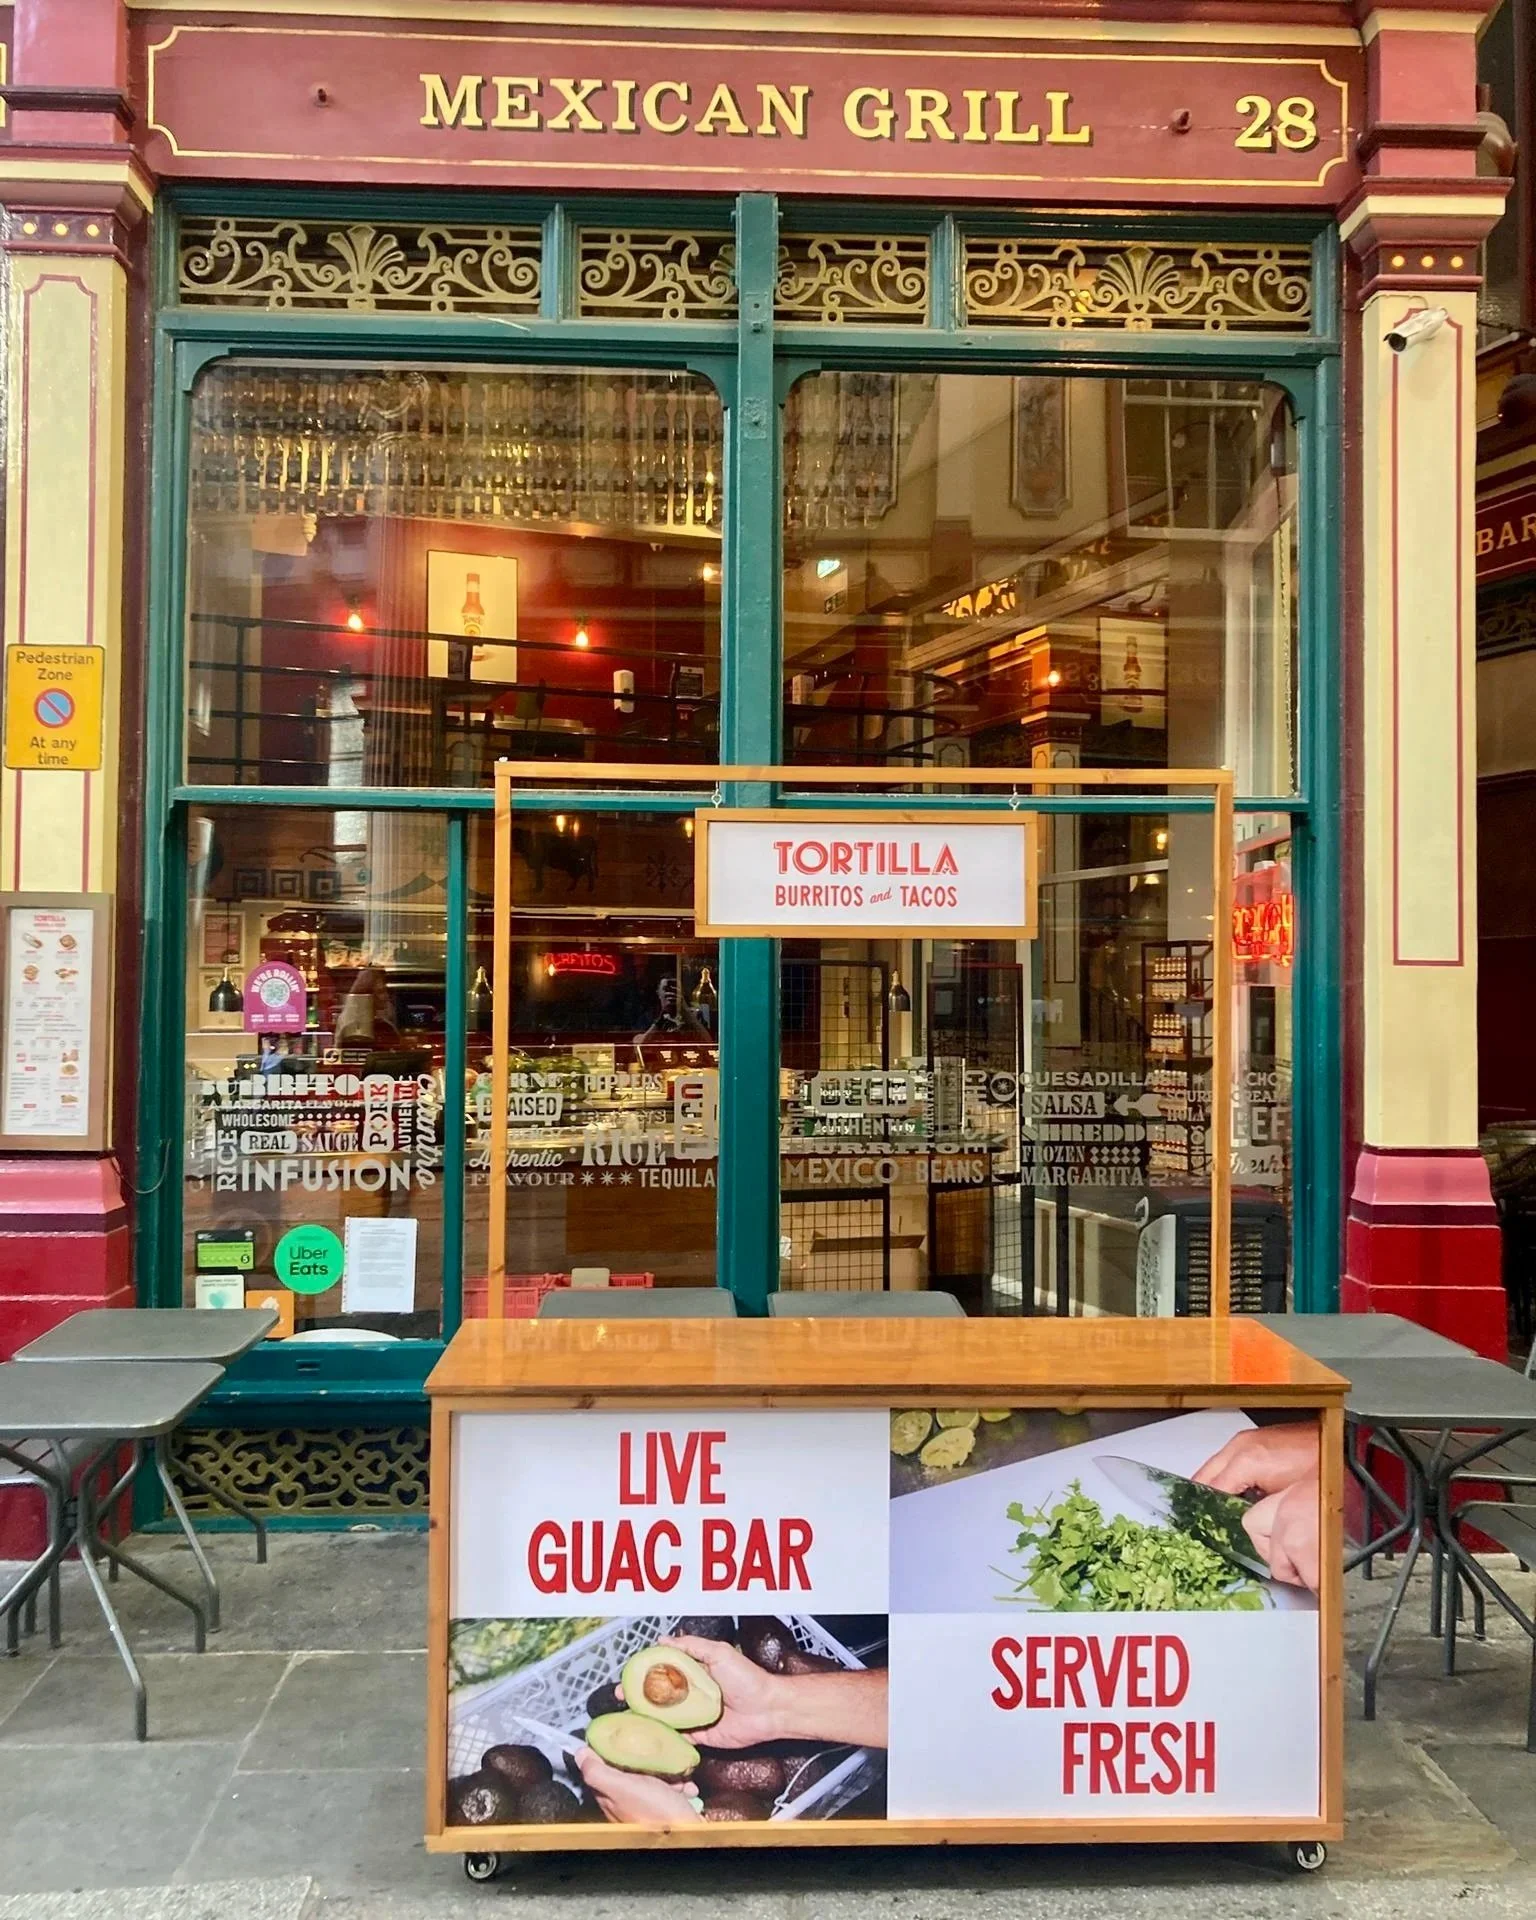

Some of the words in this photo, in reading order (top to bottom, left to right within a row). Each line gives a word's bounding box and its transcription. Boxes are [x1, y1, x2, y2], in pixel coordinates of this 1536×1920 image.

[419, 73, 811, 136] MEXICAN
[843, 86, 1092, 145] GRILL
[1234, 95, 1319, 150] 28
[16, 651, 94, 665] Pedestrian
[37, 668, 73, 681] Zone
[30, 737, 46, 749] At
[51, 738, 76, 751] any
[38, 753, 69, 766] time
[773, 841, 960, 876] TORTILLA
[775, 885, 863, 907] BURRITOS
[869, 888, 893, 905] and
[900, 886, 958, 907] TACOS
[1031, 1094, 1098, 1116] SALSA
[222, 1113, 296, 1127] WHOLESOME
[248, 1134, 290, 1150] REAL
[301, 1132, 359, 1153] SAUCE
[581, 1130, 667, 1167] RICE
[216, 1130, 238, 1192] RICE
[1021, 1145, 1086, 1163] FROZEN
[241, 1158, 411, 1192] INFUSION
[638, 1168, 715, 1190] TEQUILA
[785, 1157, 900, 1184] MEXICO
[916, 1159, 984, 1184] BEANS
[1020, 1166, 1144, 1187] MARGARITA
[289, 1247, 328, 1260] Uber
[290, 1262, 328, 1276] Eats
[619, 1431, 727, 1505] LIVE
[528, 1520, 682, 1593] GUAC
[701, 1518, 814, 1592] BAR
[991, 1635, 1190, 1711] SERVED
[1062, 1721, 1216, 1796] FRESH
